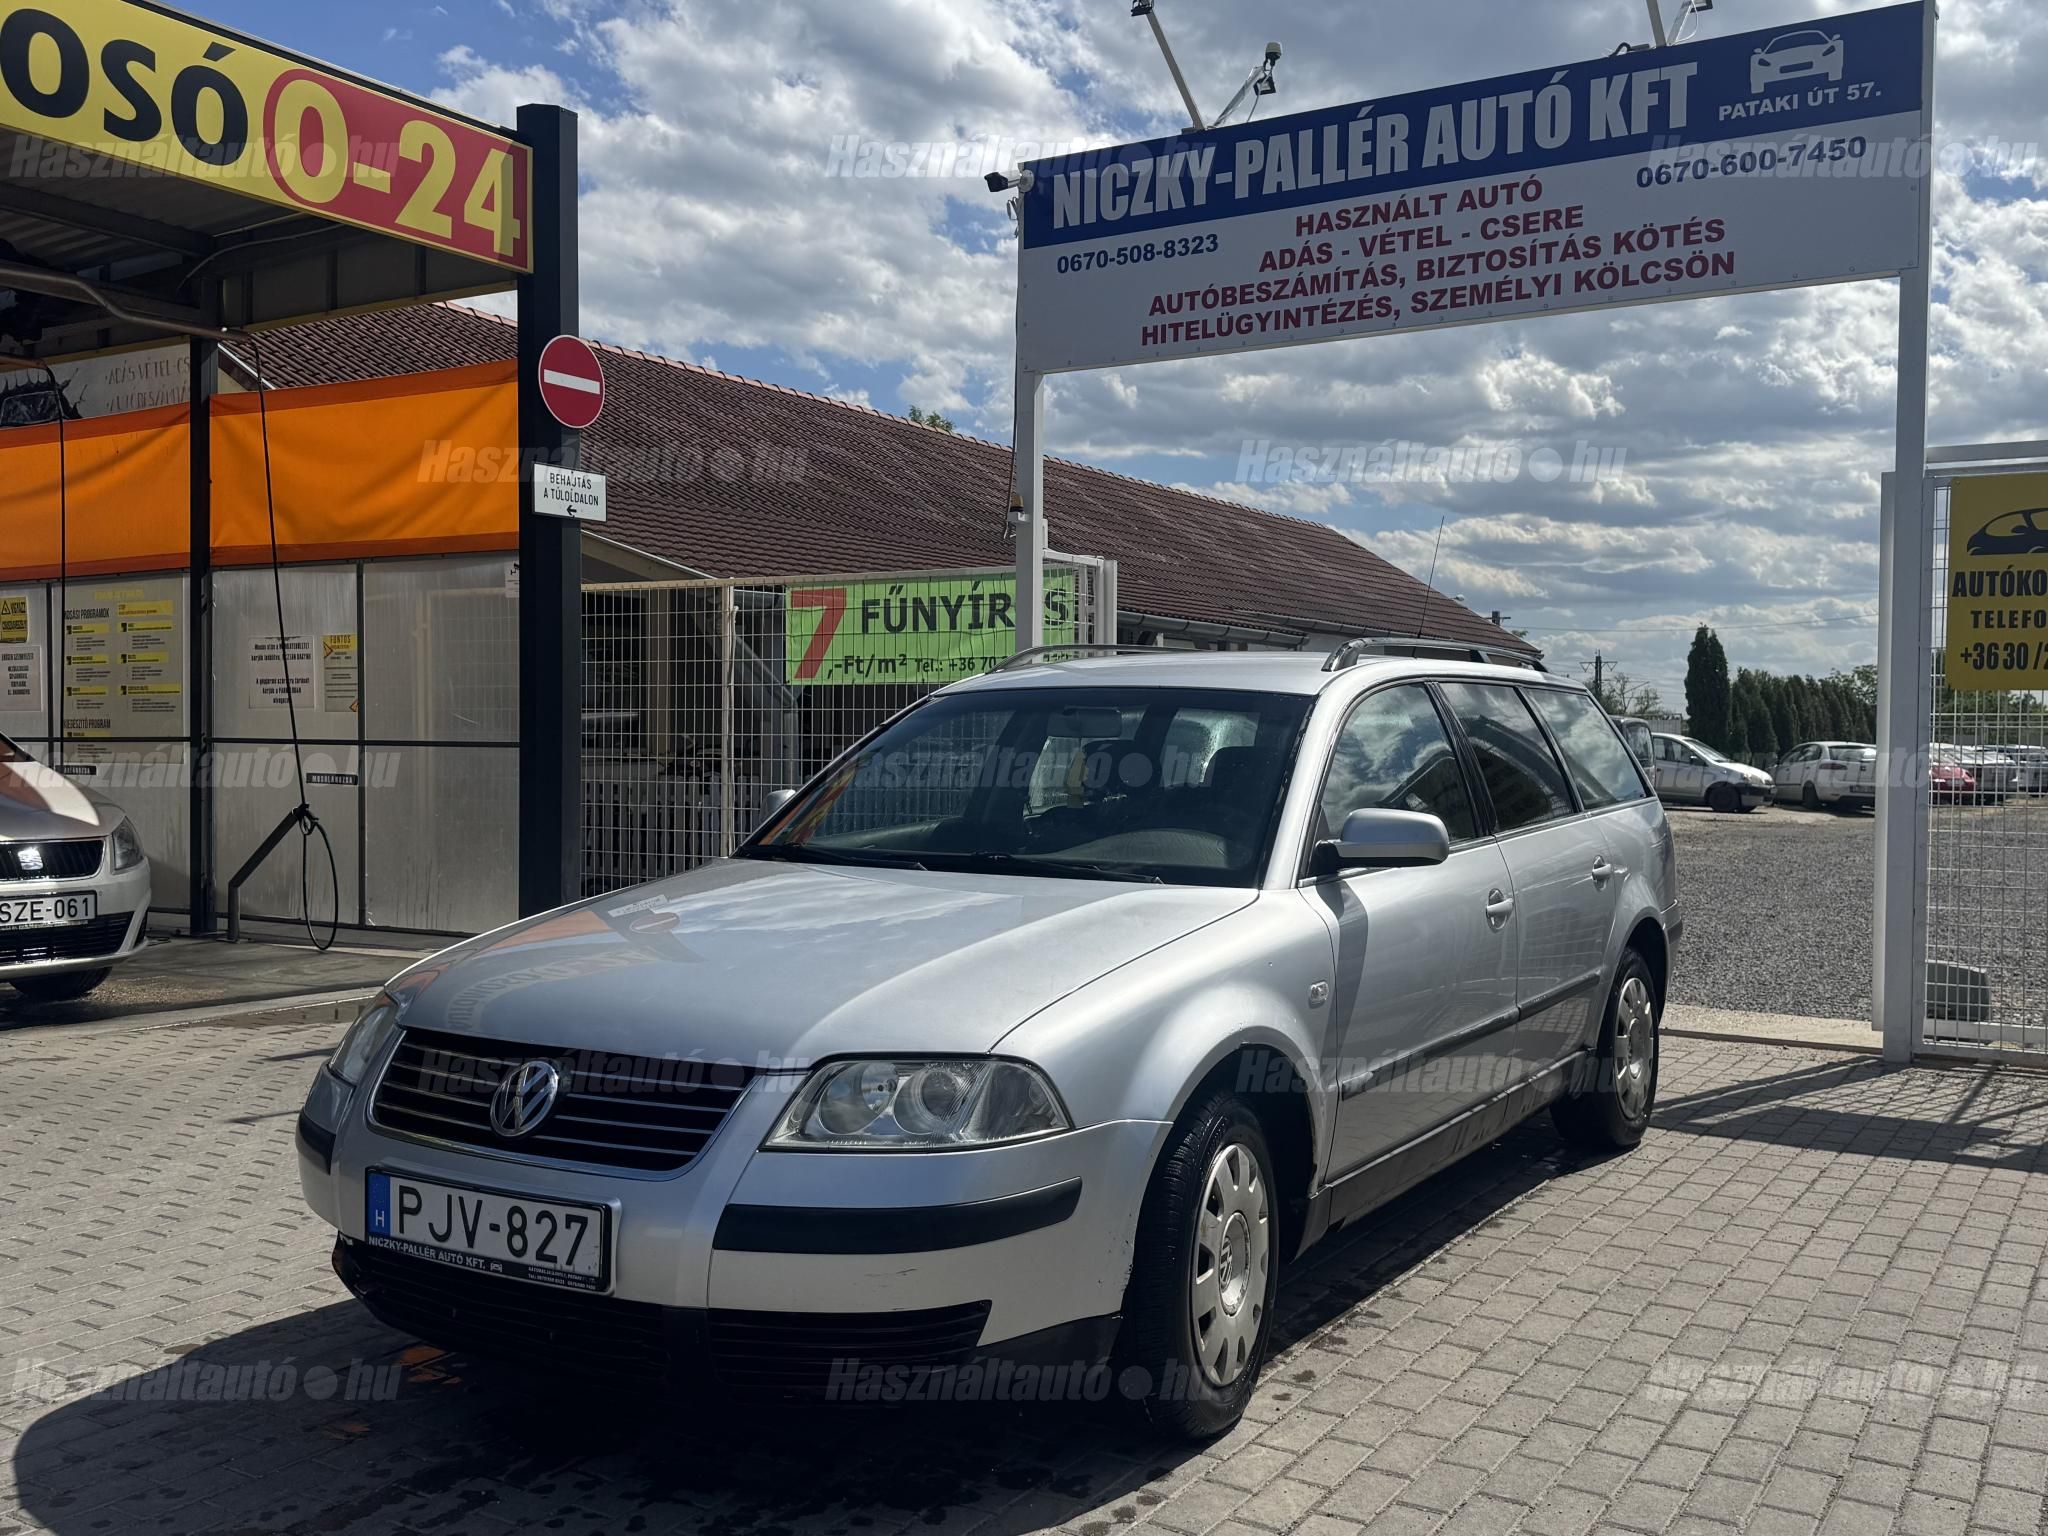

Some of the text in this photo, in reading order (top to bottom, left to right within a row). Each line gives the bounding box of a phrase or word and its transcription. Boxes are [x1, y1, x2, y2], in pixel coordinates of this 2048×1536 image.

[1718, 81, 1882, 121] PATAKI ÚT 57.
[274, 79, 520, 257] 0-24
[1053, 62, 1698, 229] NICZKY-PALLÉR AUTÓ KFT
[1636, 135, 1867, 188] 0670-600-7450
[1296, 174, 1543, 237] HASZNÁLT AUTÓ
[1057, 233, 1218, 274] 0670-508-8323
[1149, 215, 1726, 317] AUTÓBESZÁMÍTÁS, BIZTOSÍTÁS KÖTÉS
[1259, 238, 1333, 273] ADÁS
[1358, 222, 1451, 258] VÉTEL
[1481, 205, 1584, 241] CSERE
[1141, 252, 1735, 346] HITELÜGYINTÉZÉS, SZEMÉLYI KÖLCSÖN
[544, 487, 549, 499] A
[550, 473, 592, 490] BEHAJTÁS
[791, 581, 1069, 679] 7 FŰNYÍRS
[915, 658, 943, 673] Tel.:
[949, 656, 975, 673] +36
[0, 897, 88, 923] SZE-061
[368, 1236, 486, 1269] NICZKY-PALLÉR AUTÓ KFT.
[375, 1185, 589, 1265] H PJV-827
